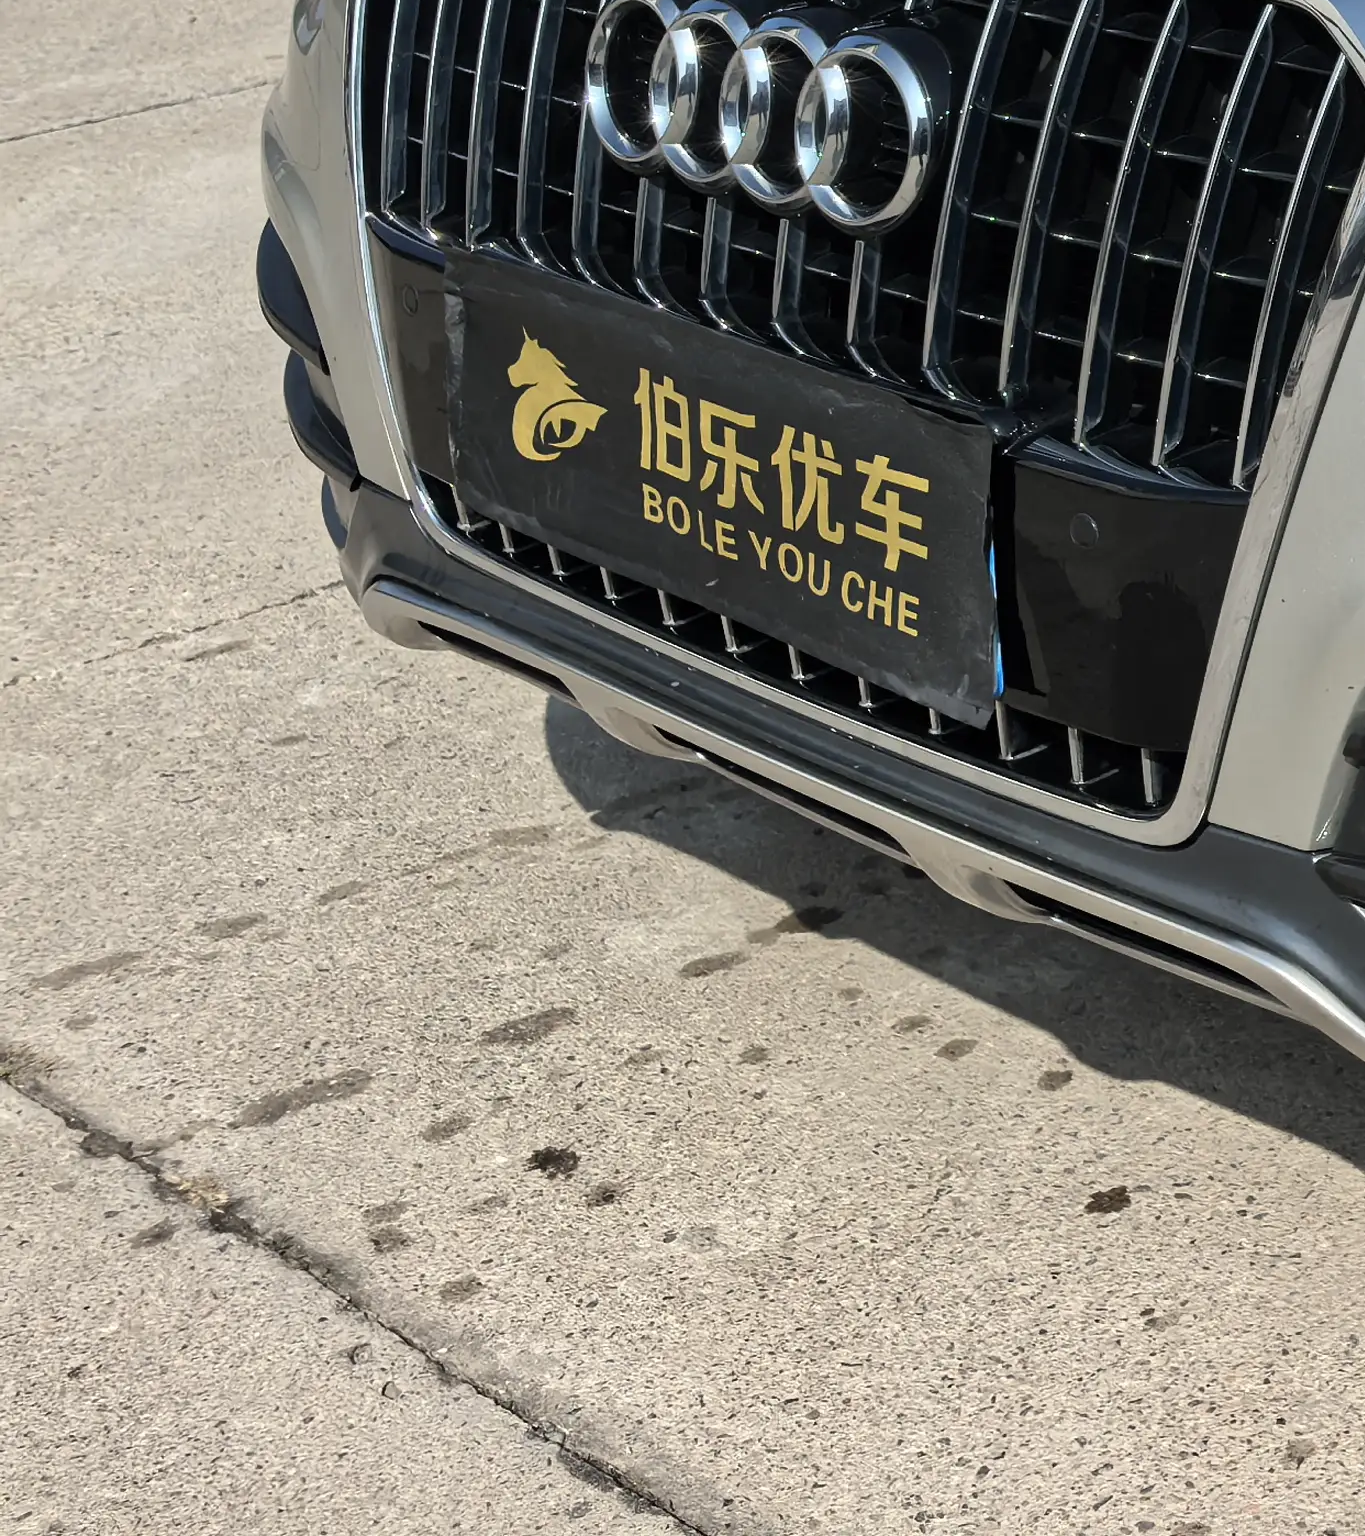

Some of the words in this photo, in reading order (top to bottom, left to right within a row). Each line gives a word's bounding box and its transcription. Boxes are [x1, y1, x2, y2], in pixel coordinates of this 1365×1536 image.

[633, 367, 930, 573] 伯乐优车
[748, 530, 831, 597] YOU
[841, 571, 920, 638] CHE
